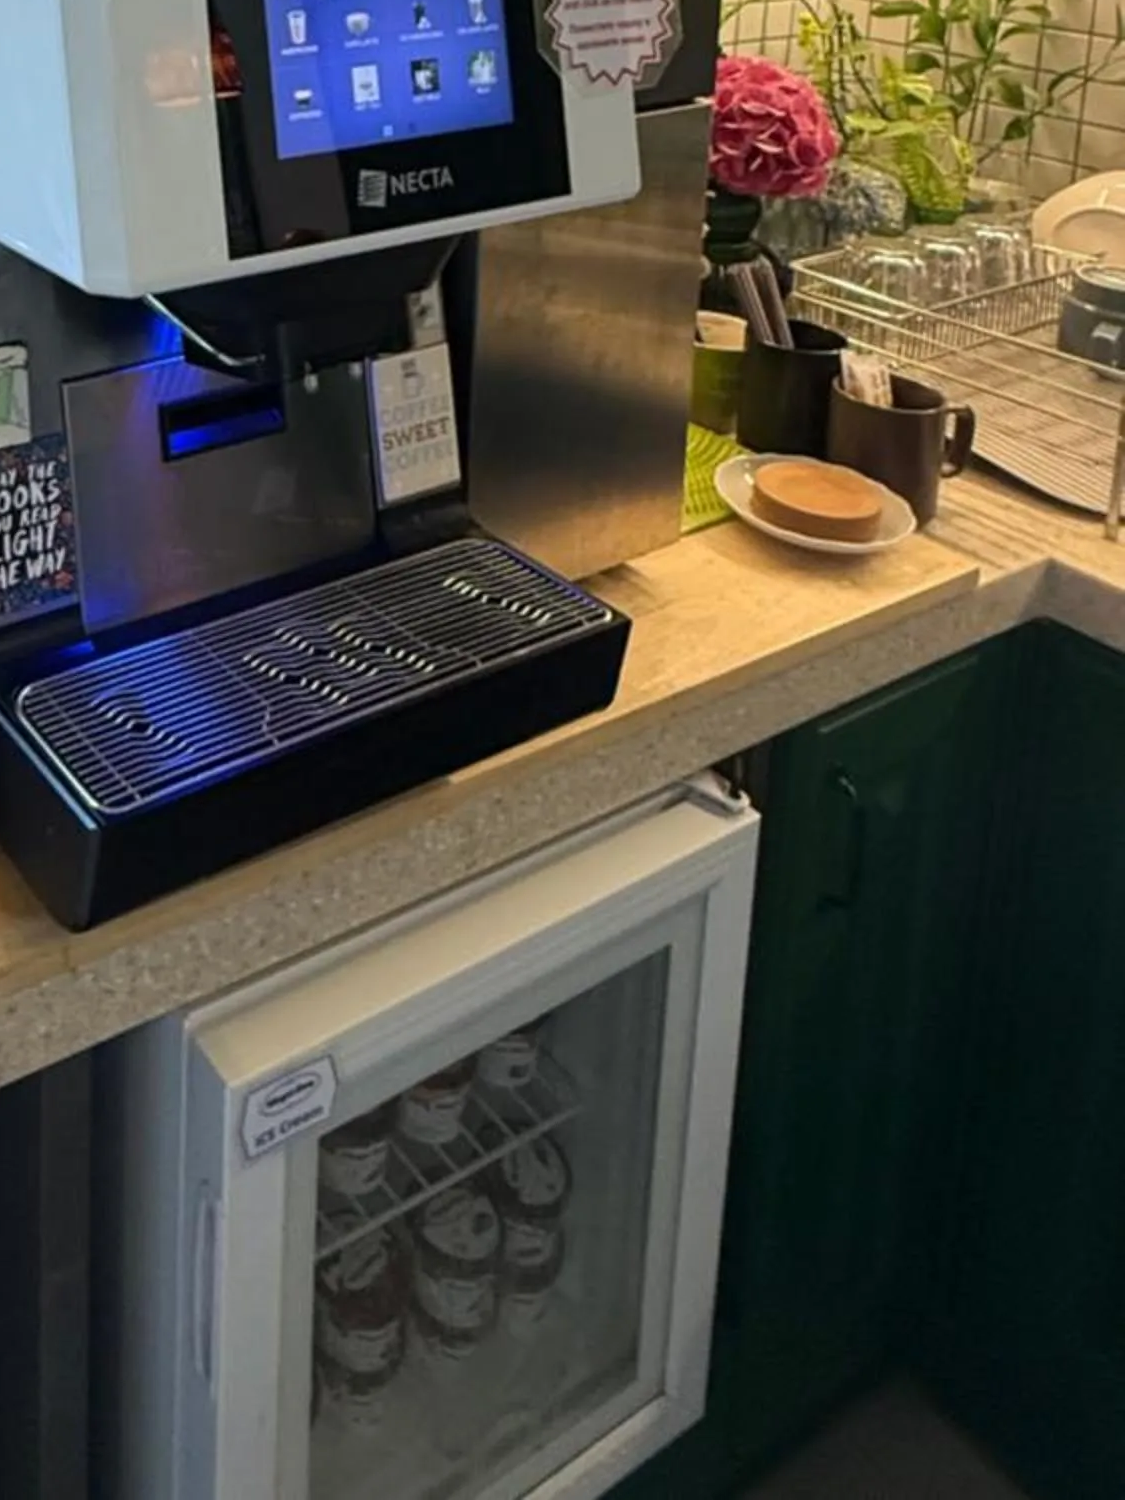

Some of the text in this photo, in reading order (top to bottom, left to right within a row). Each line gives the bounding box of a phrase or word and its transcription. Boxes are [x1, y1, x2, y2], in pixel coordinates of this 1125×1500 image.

[390, 165, 455, 197] NECTA
[381, 415, 451, 453] SWEET
[27, 461, 58, 481] THE
[19, 503, 63, 528] READ
[25, 546, 67, 580] WAY
